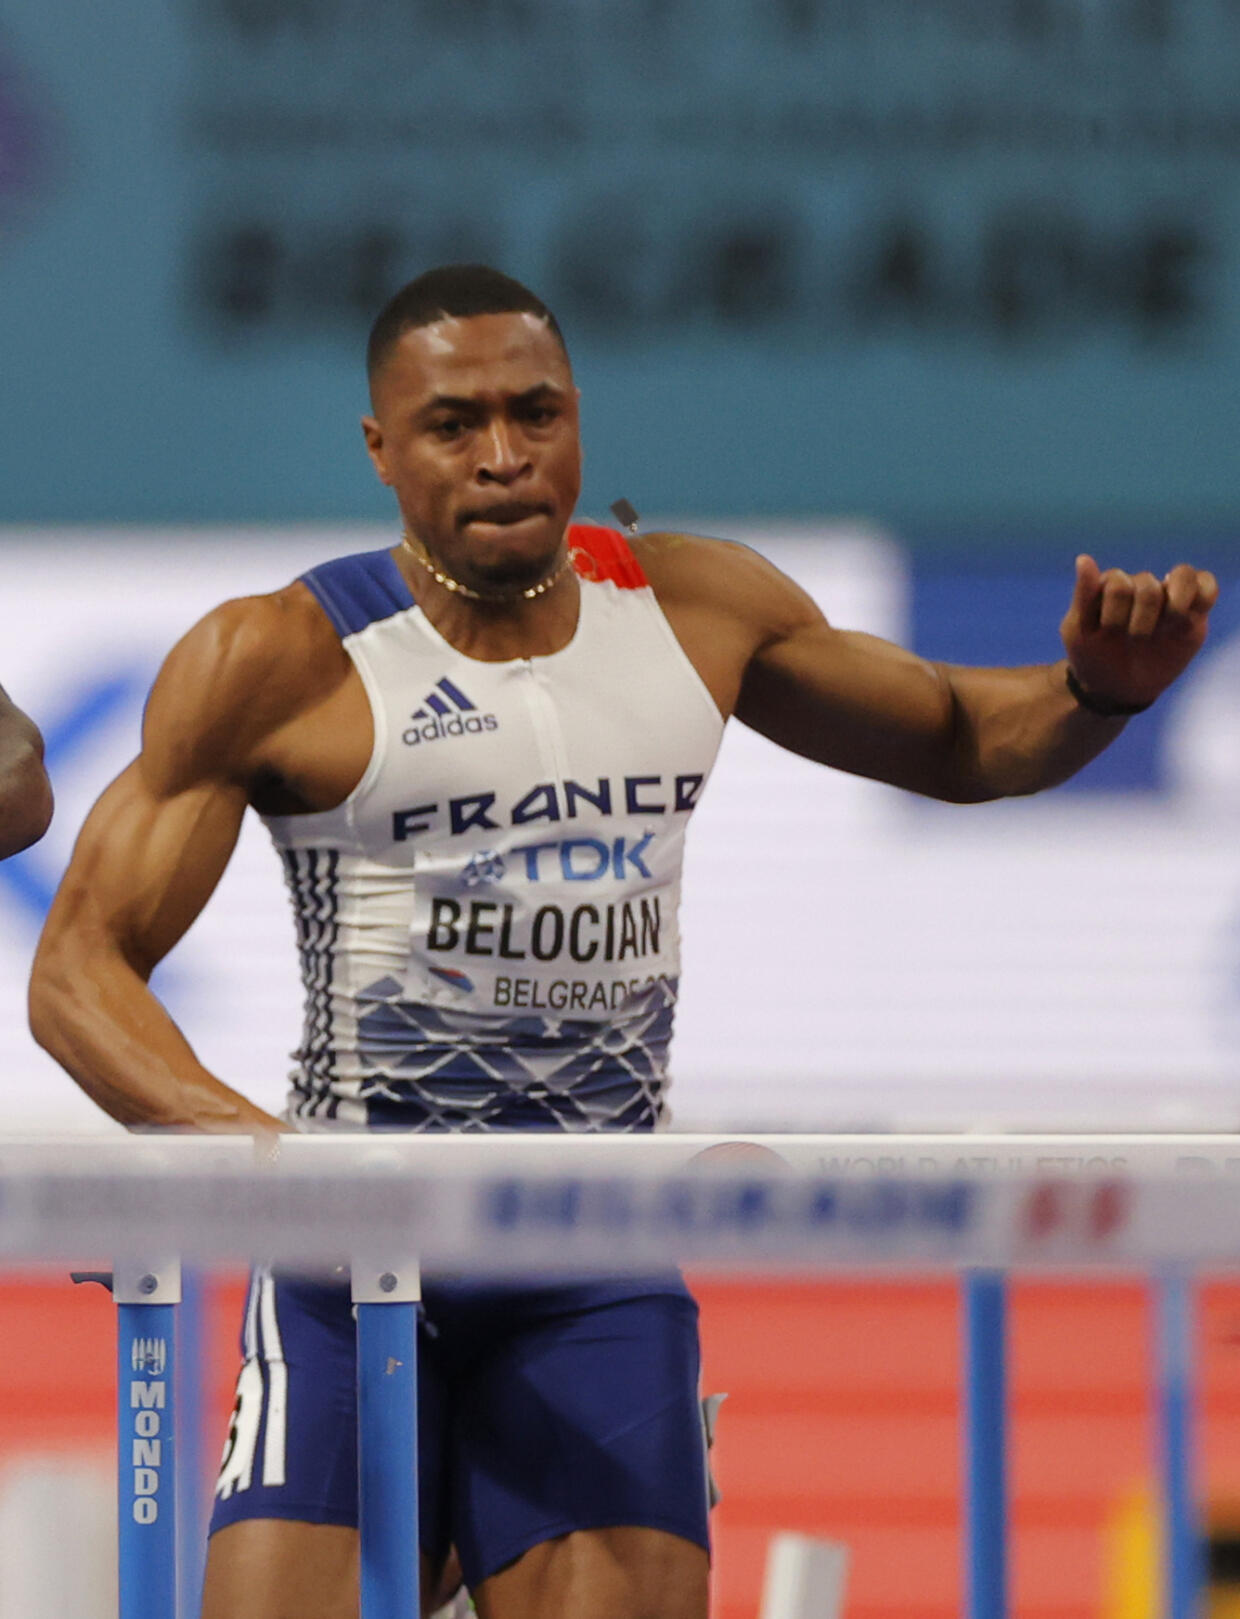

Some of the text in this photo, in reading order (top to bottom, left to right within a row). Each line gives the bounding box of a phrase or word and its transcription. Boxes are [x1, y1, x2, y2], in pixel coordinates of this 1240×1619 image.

[401, 711, 499, 747] adidas
[510, 832, 656, 882] TDK
[426, 895, 661, 964] BELOCIAN
[130, 1380, 166, 1525] MONDO
